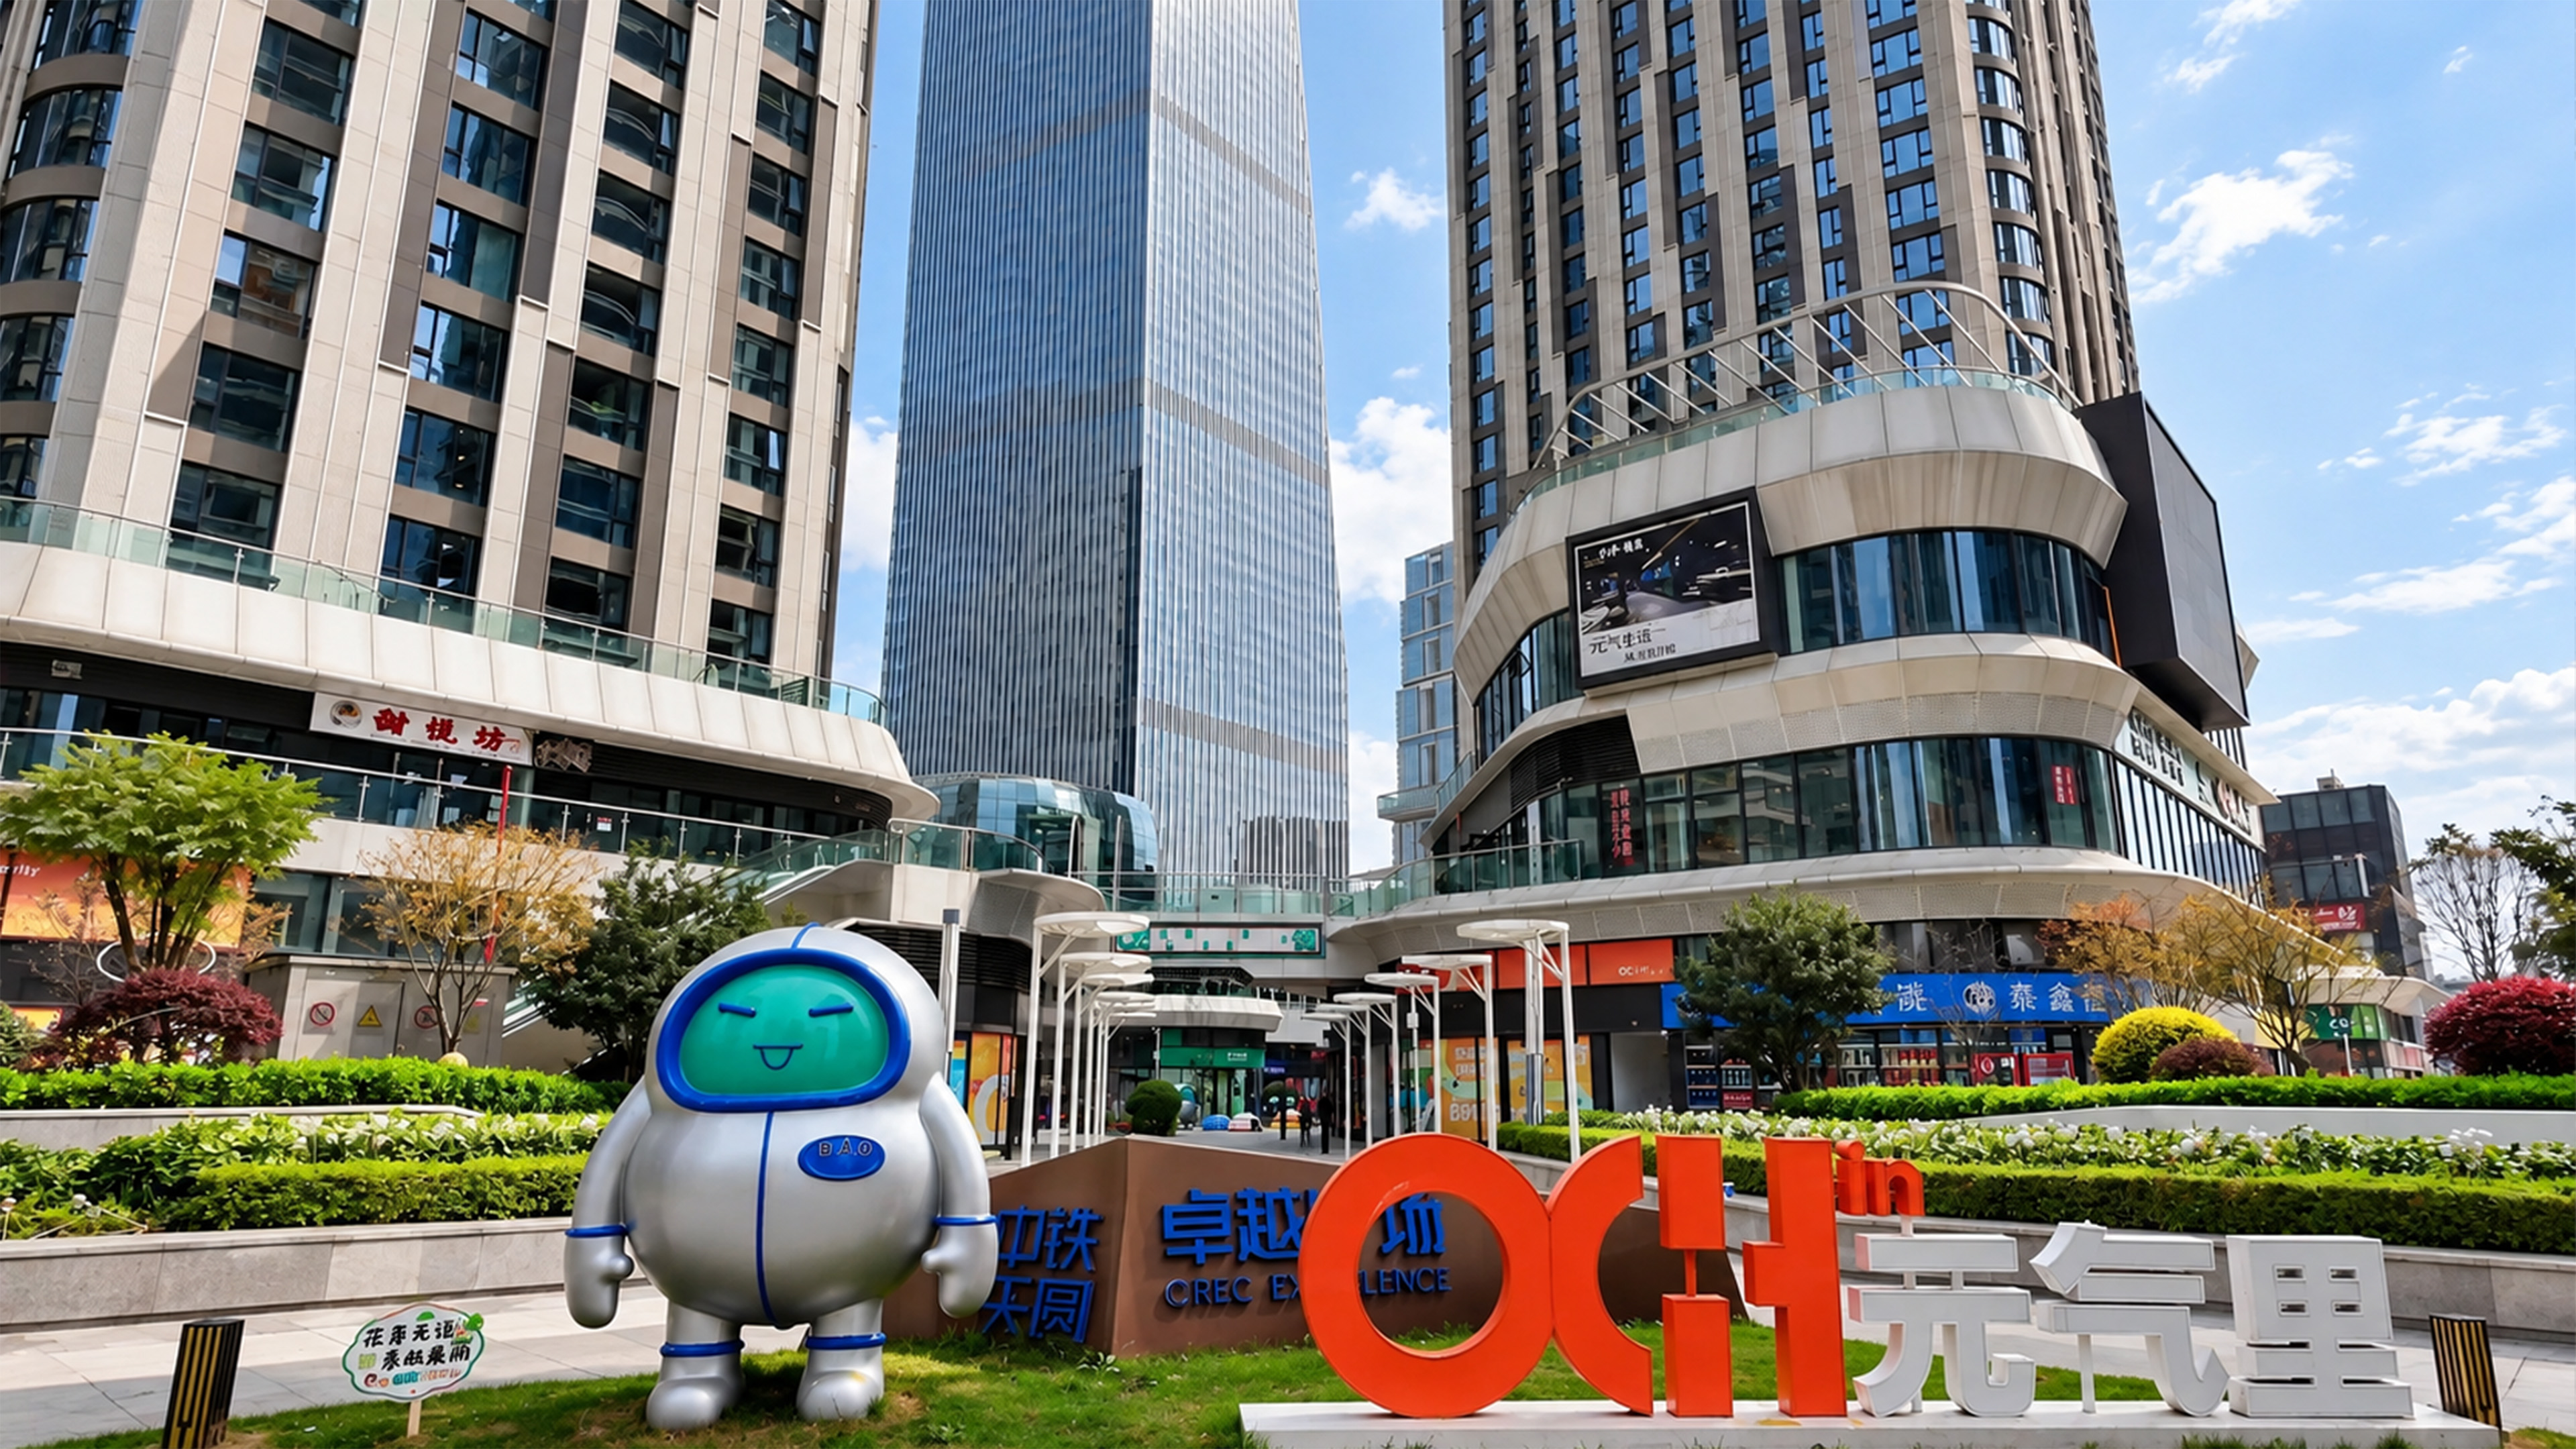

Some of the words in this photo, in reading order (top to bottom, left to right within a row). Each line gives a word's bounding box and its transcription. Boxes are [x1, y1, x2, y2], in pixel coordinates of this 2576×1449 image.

[997, 1205, 1104, 1271] 中铁
[1163, 1187, 1447, 1265] 卓越场
[1165, 1277, 1253, 1307] CREC
[1271, 1267, 1452, 1301] EXLENCE
[1848, 1220, 2415, 1419] 元气里
